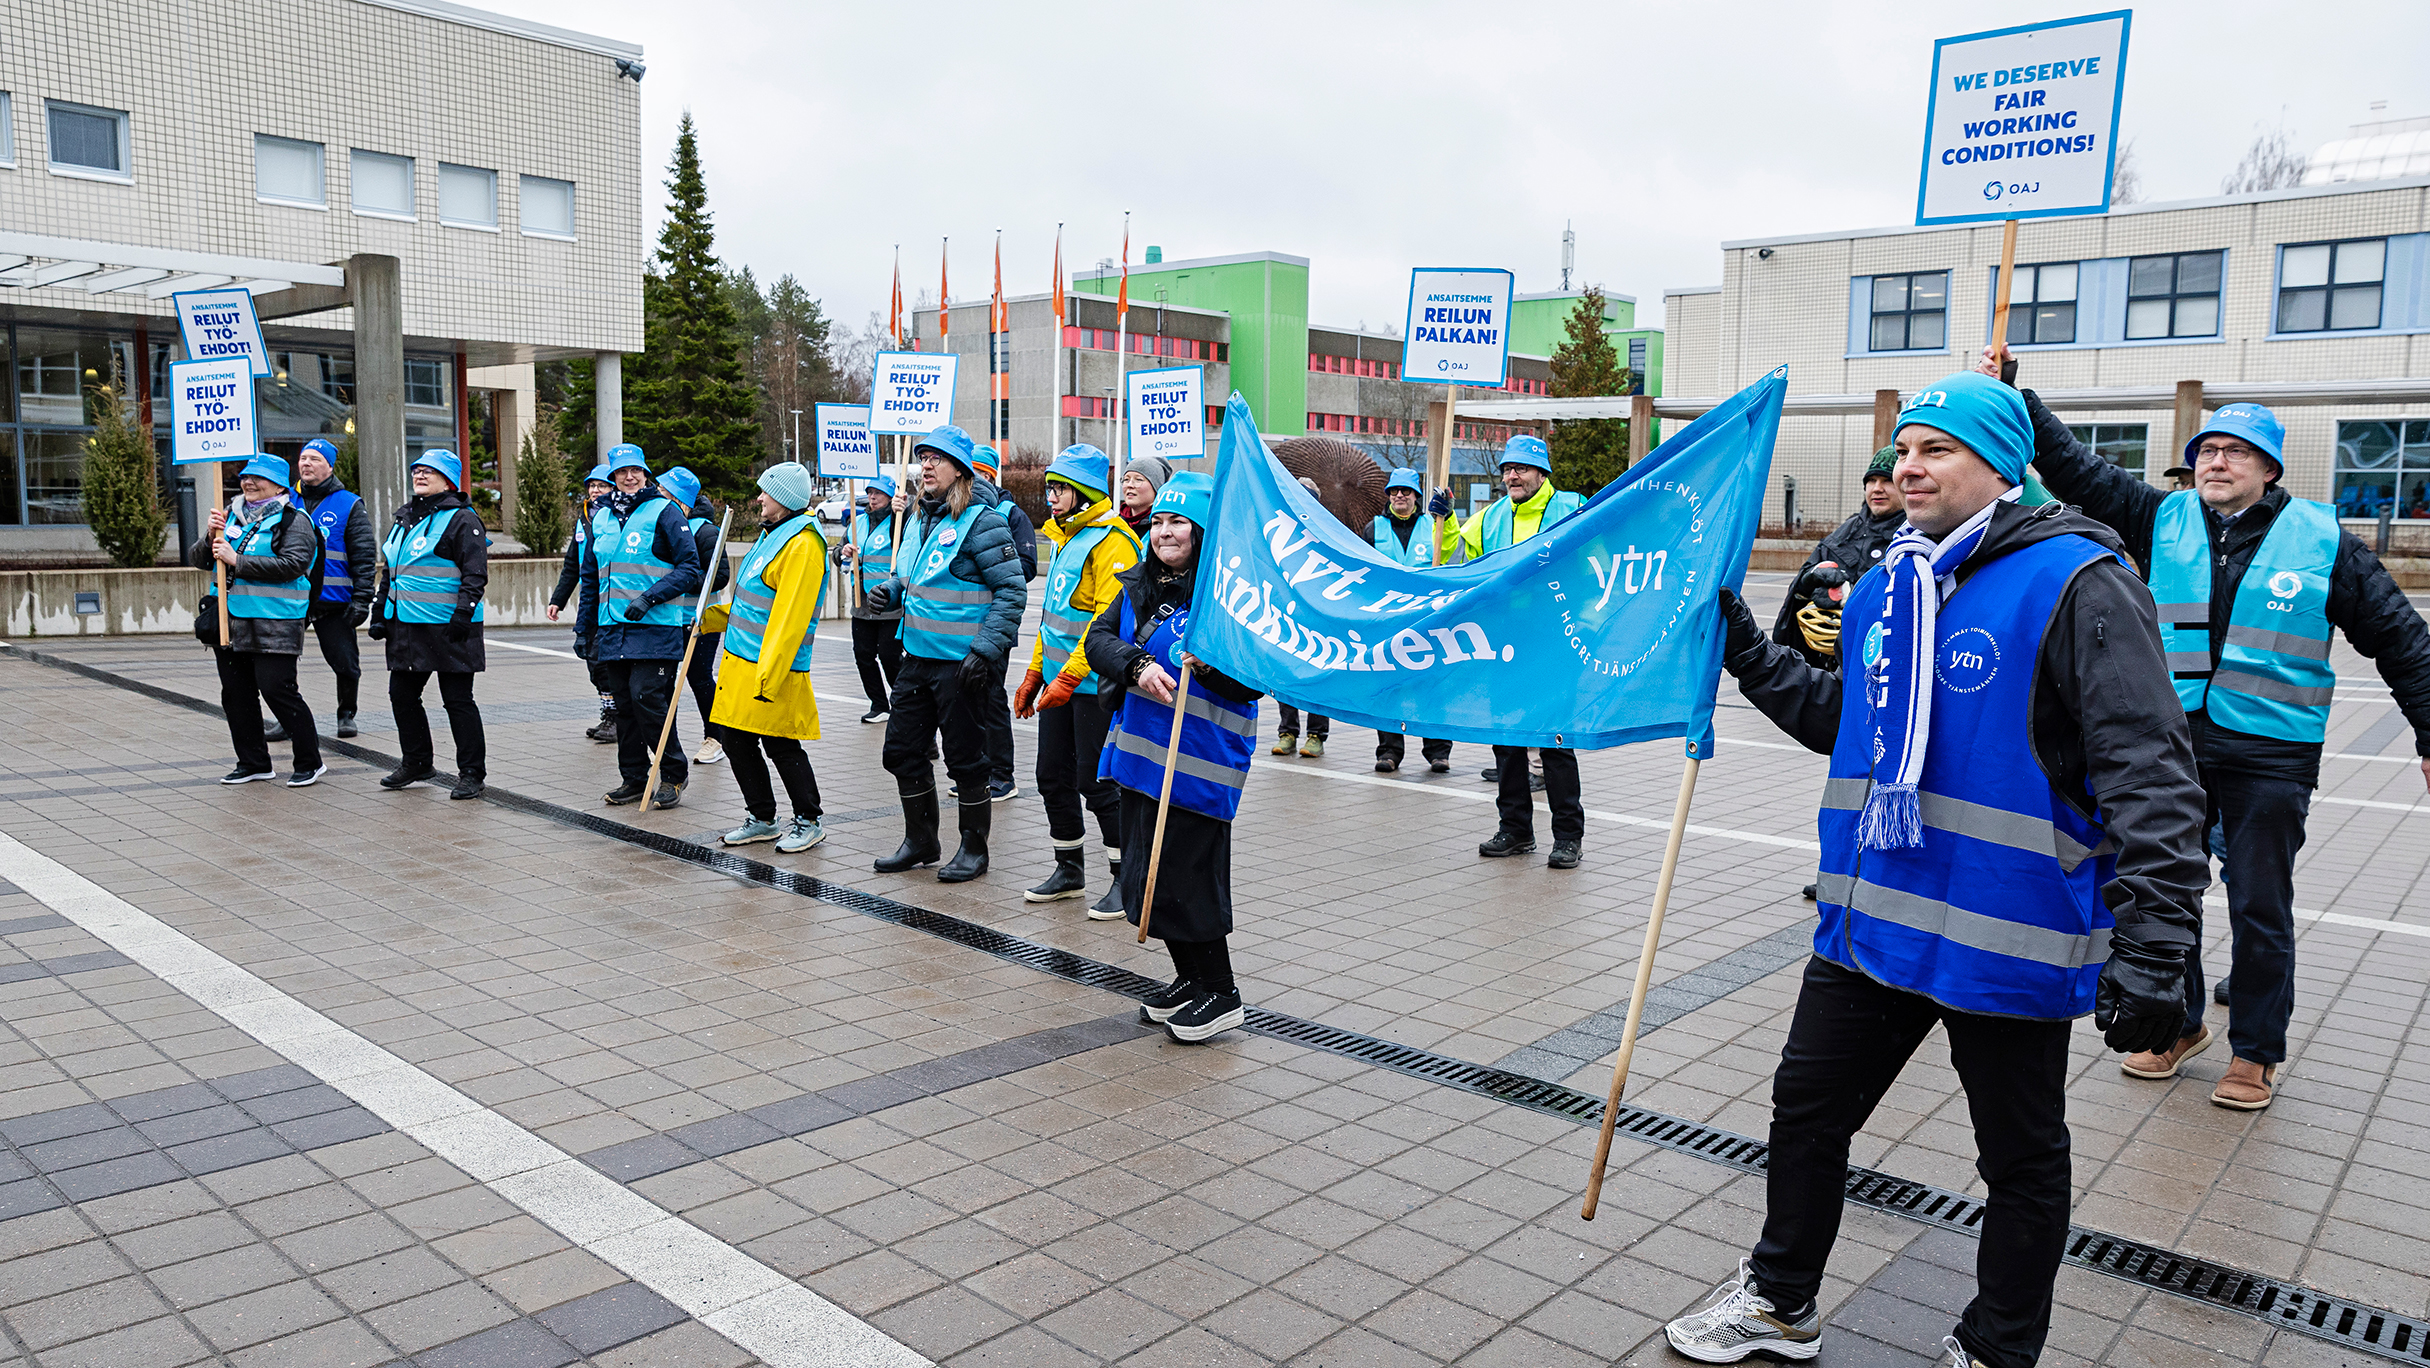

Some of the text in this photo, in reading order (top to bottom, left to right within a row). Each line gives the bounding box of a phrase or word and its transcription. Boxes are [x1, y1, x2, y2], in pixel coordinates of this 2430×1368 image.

[1953, 56, 2101, 93] WE DESERVE
[1994, 89, 2047, 112] FAIR
[1963, 110, 2078, 140] WORKING
[1941, 134, 2095, 166] CONDITIONS!
[2009, 182, 2040, 195] OAJ
[191, 302, 238, 310] ANSAITSEMME
[1426, 294, 1493, 304] ANSAITSEMME
[193, 312, 241, 326] REILUT
[1424, 307, 1492, 325] REILUN
[204, 325, 238, 341] TYÖ-
[1415, 326, 1498, 345] PALKAN!
[199, 341, 252, 356] EHDOT!
[186, 372, 236, 383] ANSAITSEMME
[889, 373, 941, 385] REILUT
[1141, 380, 1188, 390] ANSAITSEMME
[186, 383, 237, 401] REILUT
[896, 384, 931, 398] TYÖ-
[1142, 390, 1188, 406] REILUT
[194, 399, 229, 417] TYÖ-
[883, 400, 940, 413] EHDOT!
[1908, 391, 1947, 409] tn
[1148, 404, 1181, 420] TYÖ-
[186, 417, 241, 434] EHDOT!
[1140, 421, 1191, 436] EHDOT!
[827, 429, 867, 441] REILUN
[823, 441, 872, 454] PALKAN!
[1155, 489, 1187, 505] ytn
[1263, 509, 1371, 601] Nyt
[1587, 545, 1668, 613] ytn
[2266, 600, 2294, 613] OAJ
[1547, 570, 1697, 677] DE HÖGRE TJÄNSTEMÄNNEN
[1949, 650, 1984, 671] ytn
